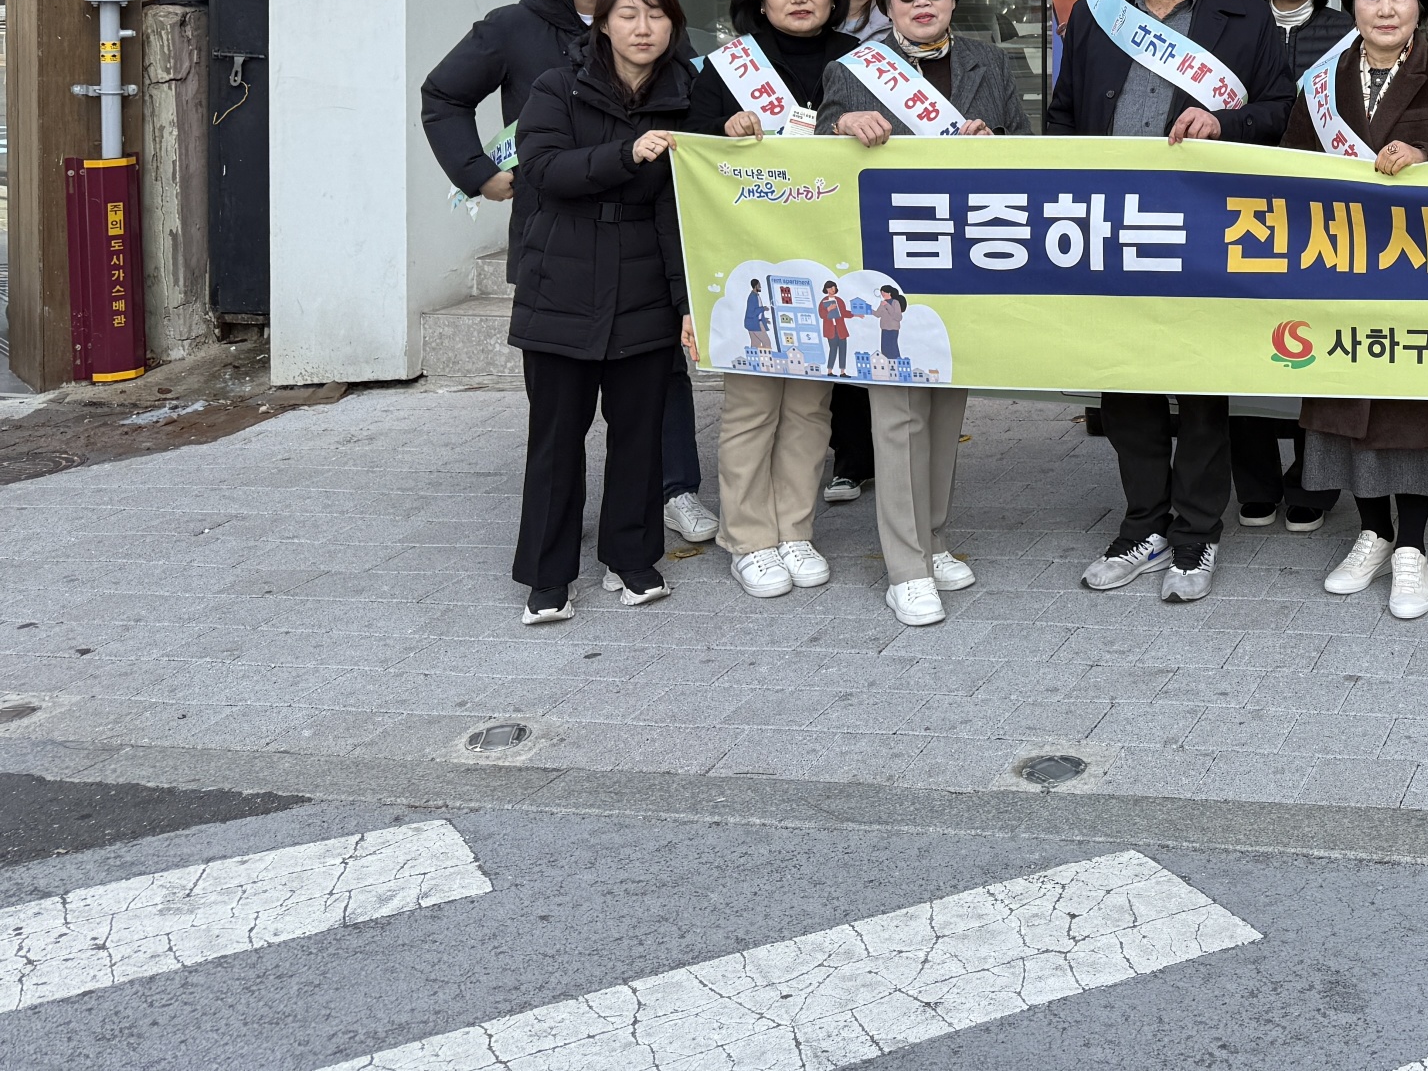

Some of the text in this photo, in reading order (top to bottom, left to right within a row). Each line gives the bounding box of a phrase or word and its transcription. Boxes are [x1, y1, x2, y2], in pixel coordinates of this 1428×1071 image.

[852, 46, 910, 91] 전세사기
[904, 89, 940, 122] 예방
[1130, 23, 1176, 64] 다가구
[1176, 52, 1213, 84] 주택
[751, 81, 785, 116] 예방
[1312, 68, 1333, 129] 전세사기
[733, 168, 791, 181] 더 나은 미래,
[734, 182, 839, 204] 새로운 사하
[109, 204, 122, 231] 주의
[888, 191, 1188, 272] 급증하는
[110, 240, 126, 327] 도시가스배관
